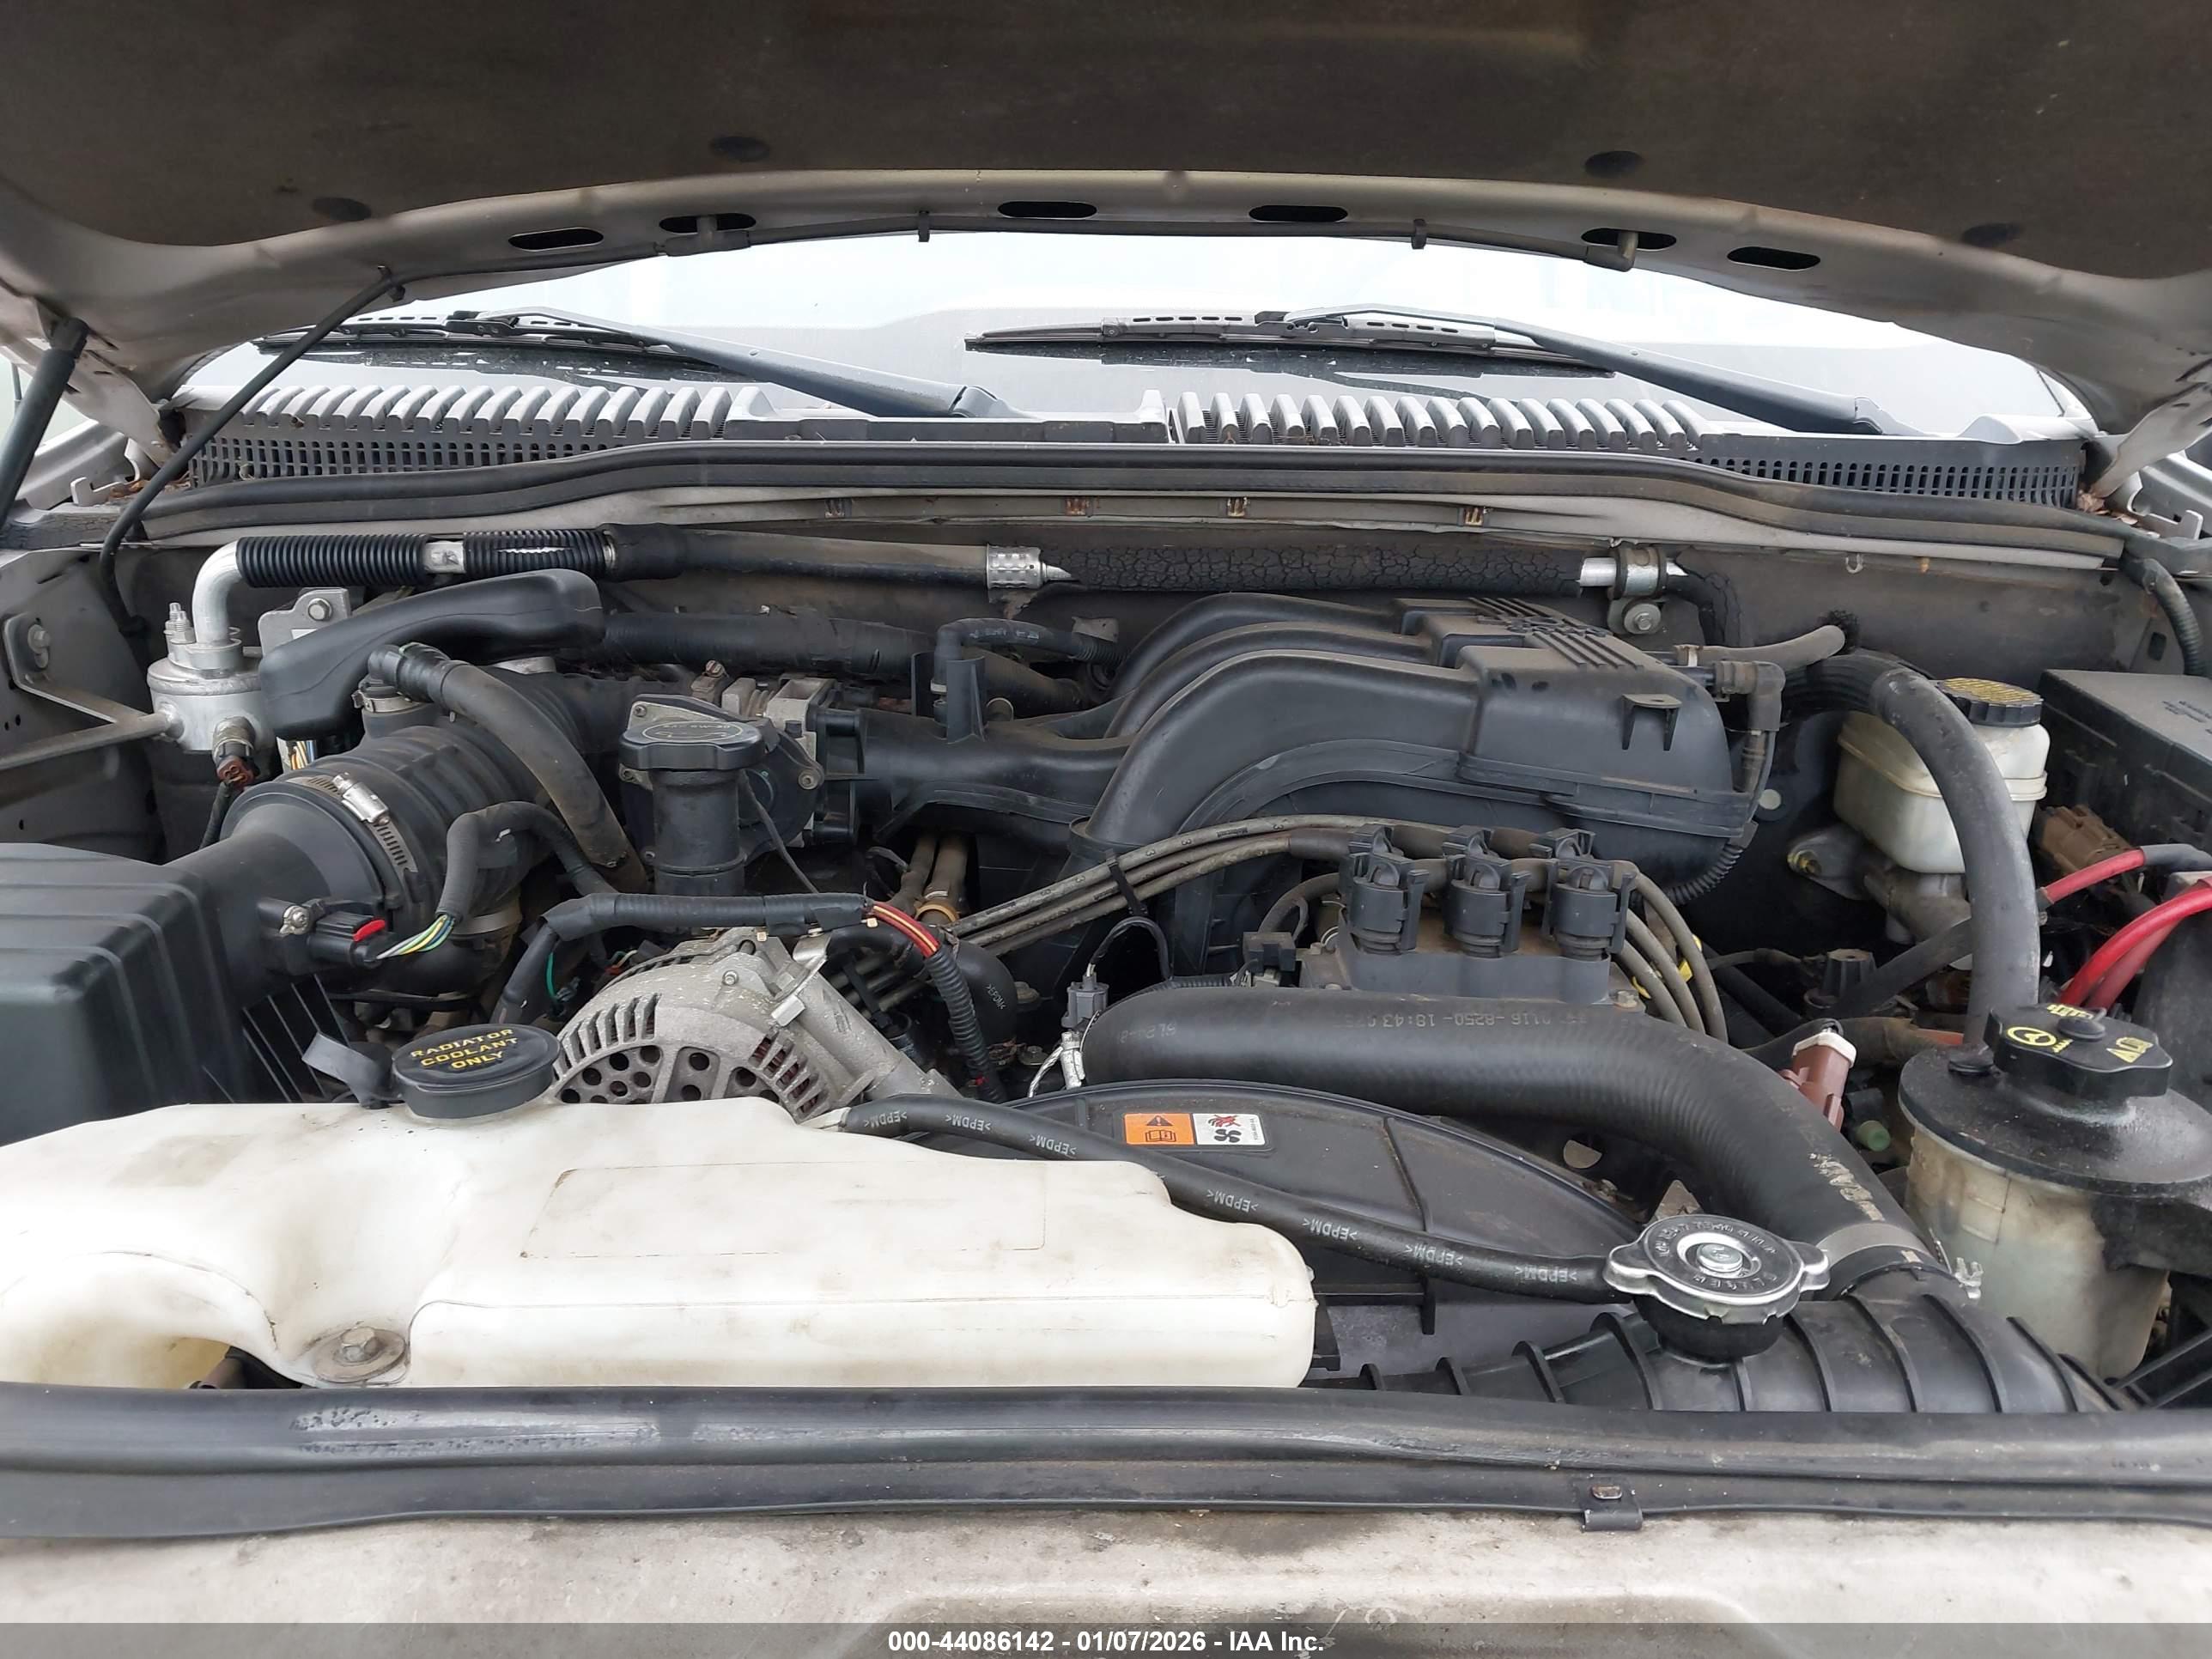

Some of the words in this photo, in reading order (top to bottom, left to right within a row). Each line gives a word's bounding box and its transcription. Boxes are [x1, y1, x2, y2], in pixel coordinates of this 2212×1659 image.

[410, 1030, 514, 1058] RADIATOR
[420, 1037, 519, 1066] COOLANT
[451, 1050, 504, 1070] ONLY
